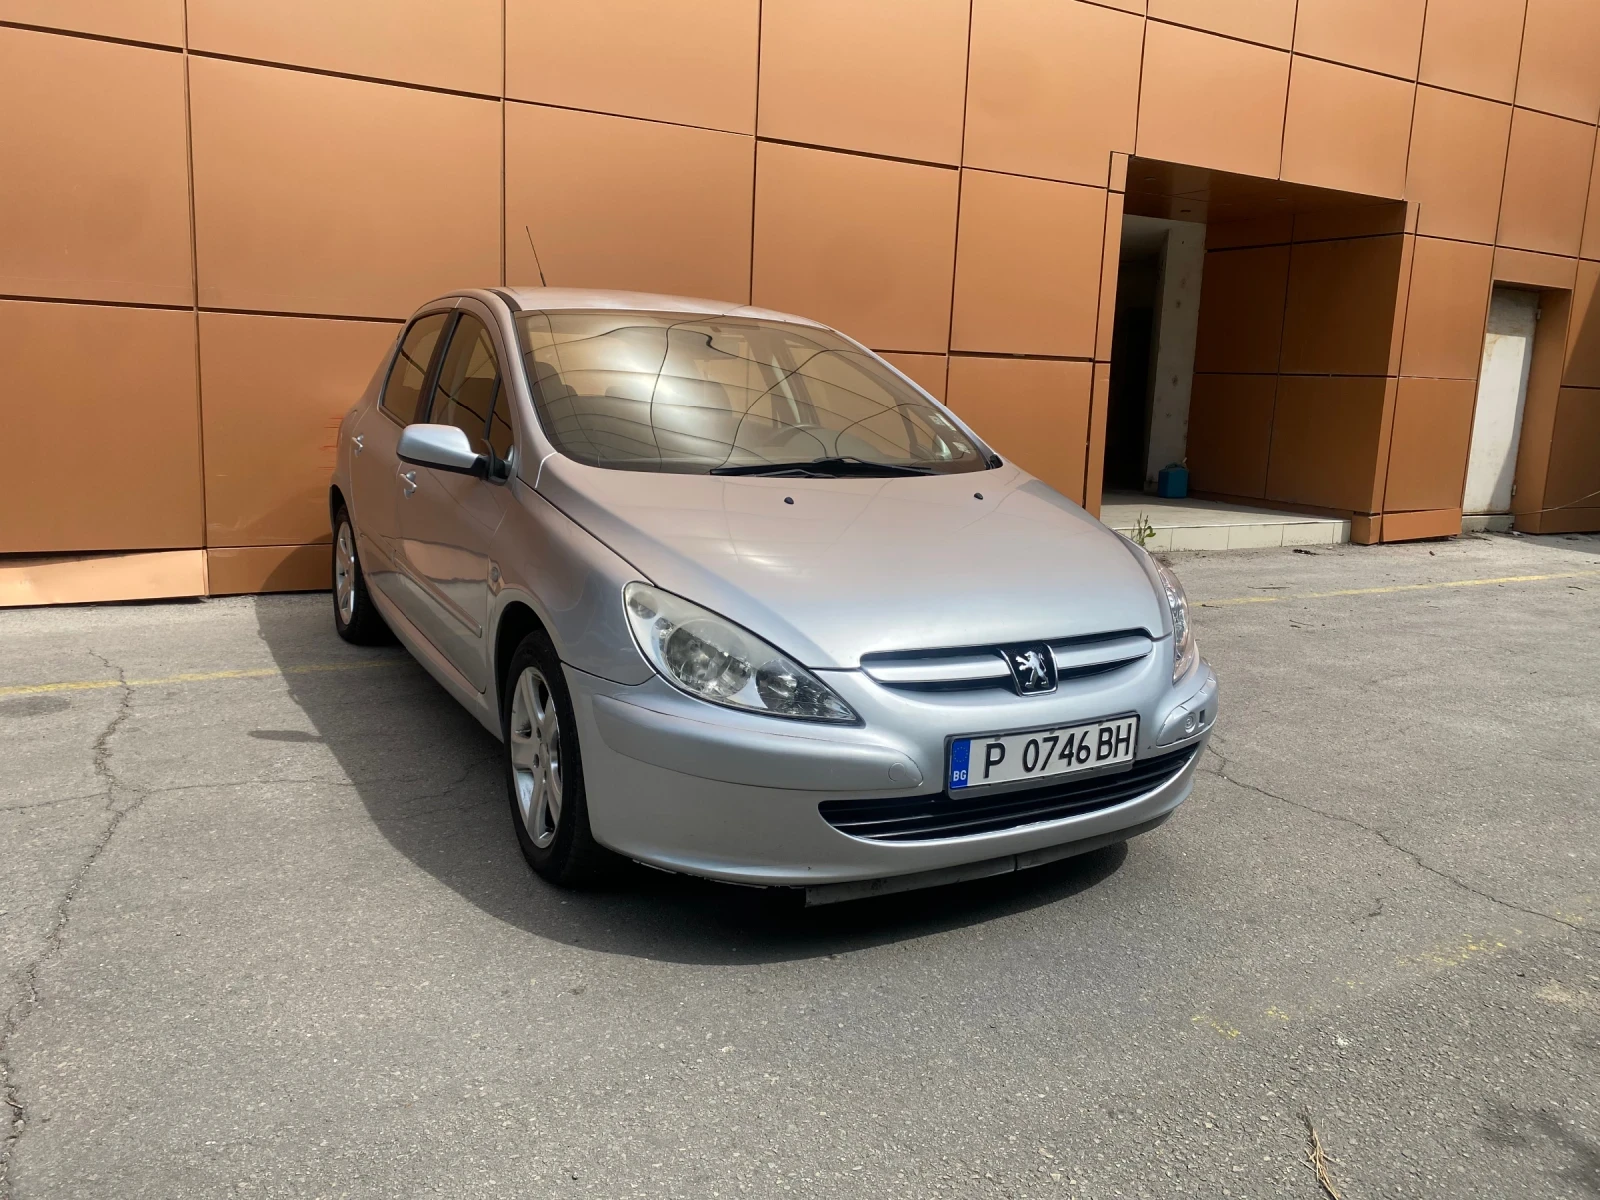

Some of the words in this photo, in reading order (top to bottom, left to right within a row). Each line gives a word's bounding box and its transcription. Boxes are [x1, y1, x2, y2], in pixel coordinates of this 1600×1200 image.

[983, 742, 1006, 779] P
[1022, 731, 1091, 773] 0746
[1096, 723, 1132, 762] BH
[953, 769, 967, 782] BG
